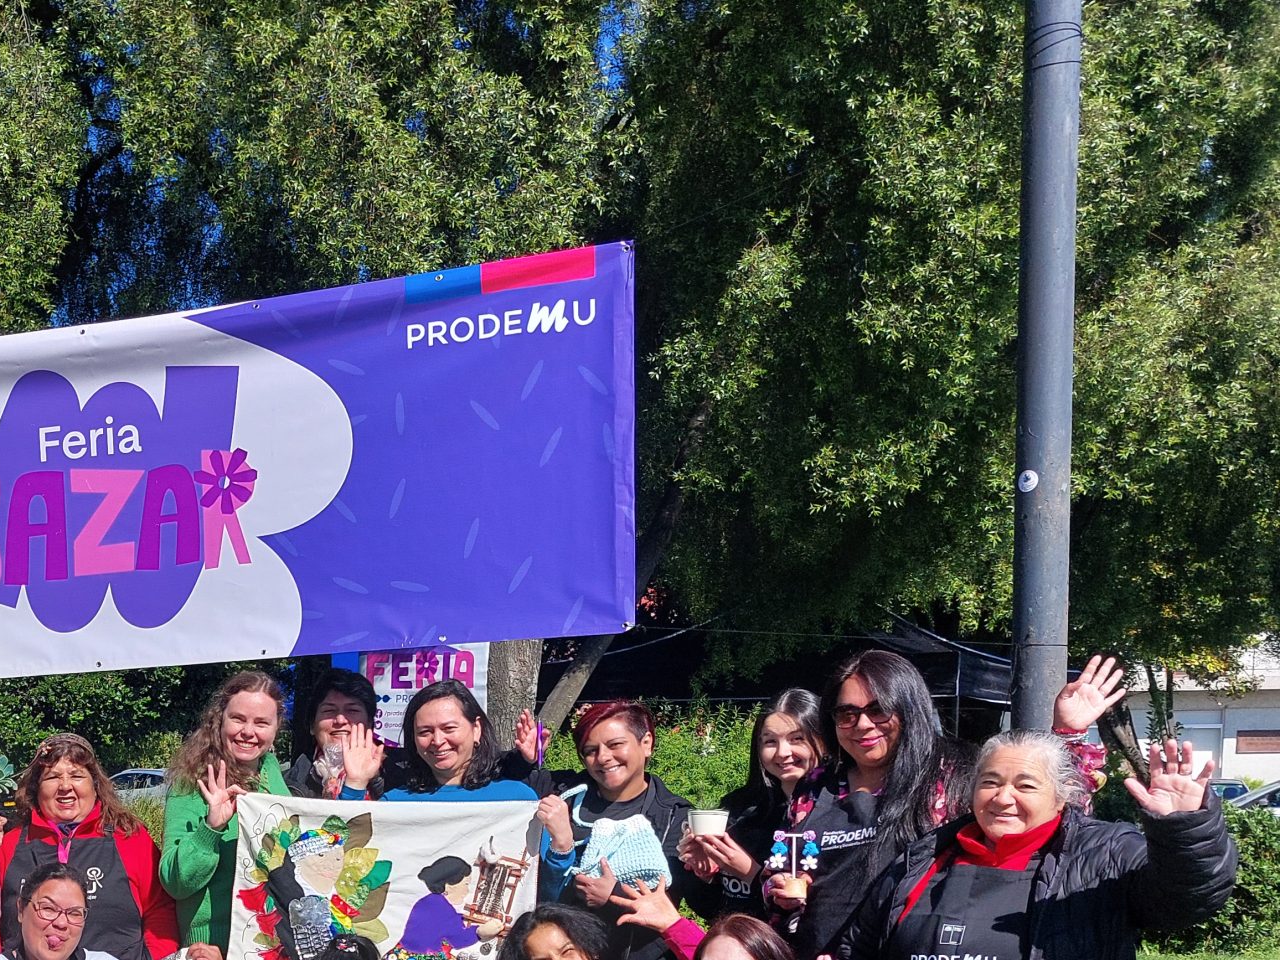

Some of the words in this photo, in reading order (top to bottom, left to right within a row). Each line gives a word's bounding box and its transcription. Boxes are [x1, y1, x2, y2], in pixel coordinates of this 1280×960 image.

[406, 298, 596, 350] PRODEMU
[38, 415, 143, 463] Feria
[365, 649, 475, 689] FERIA
